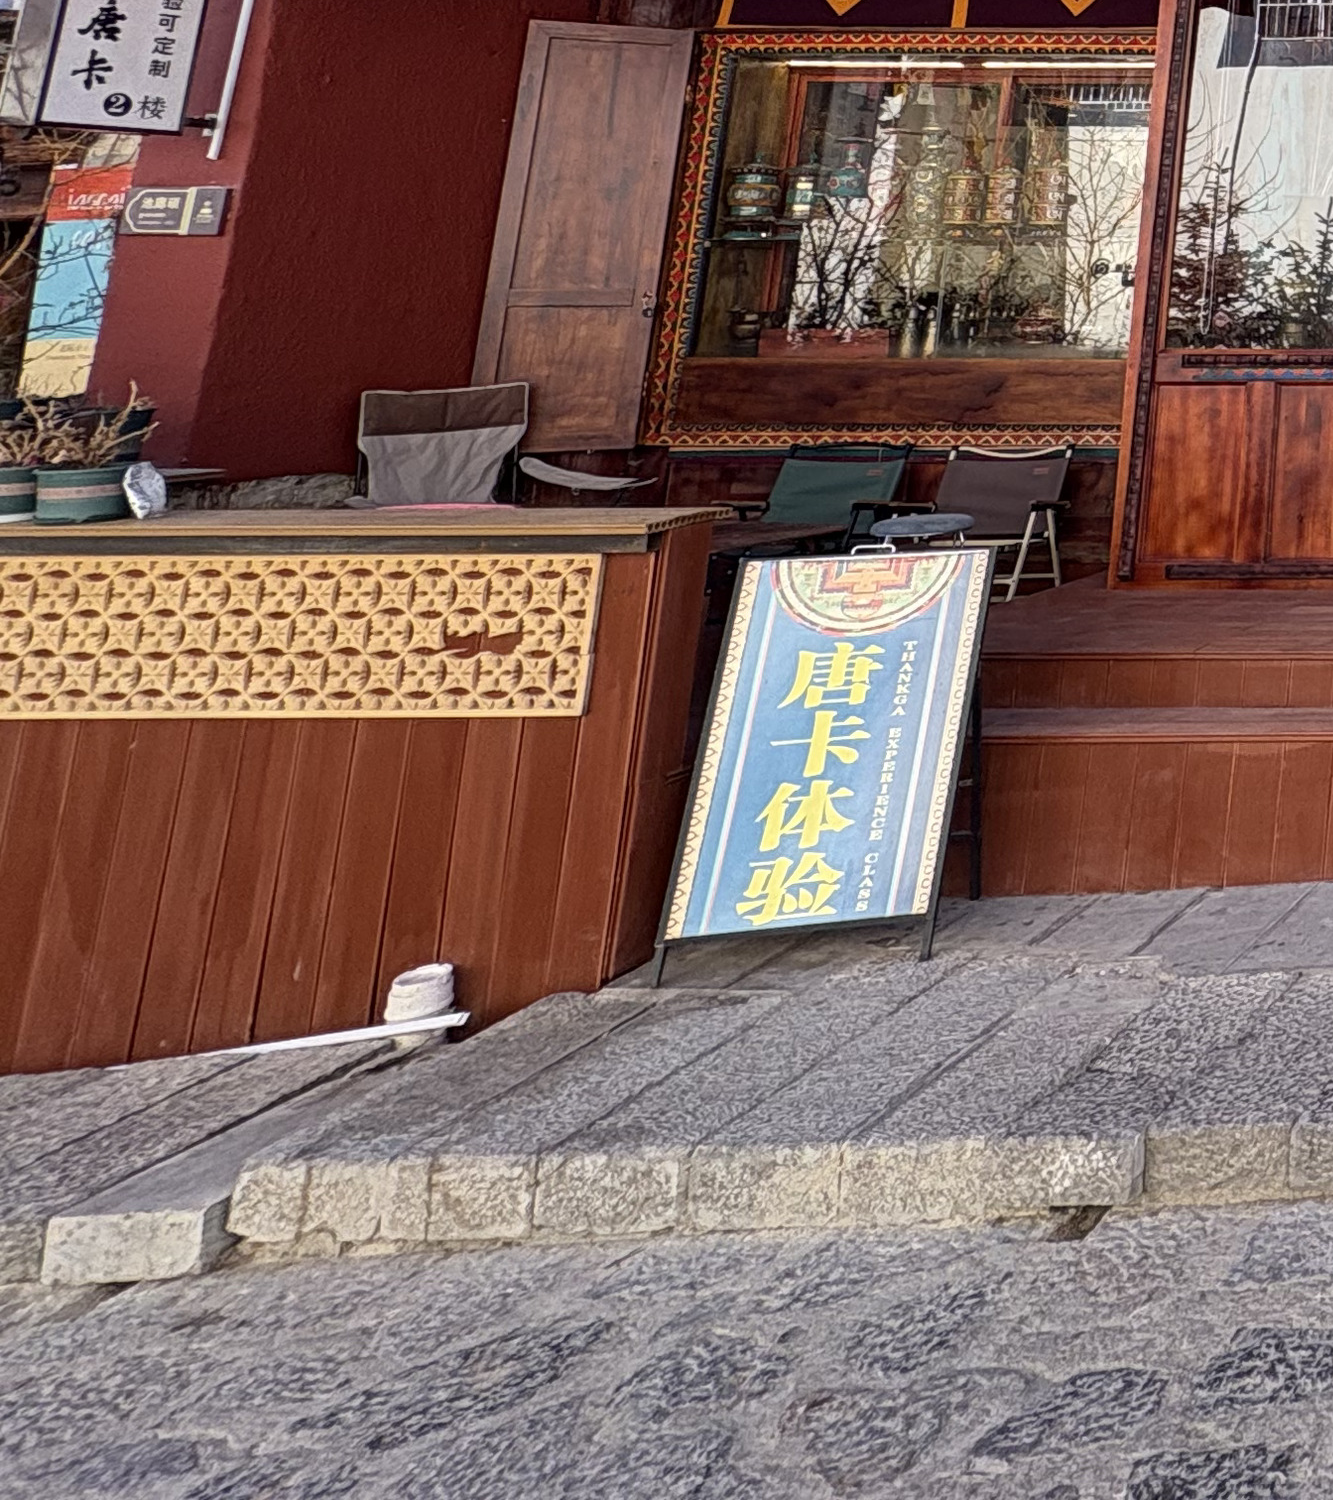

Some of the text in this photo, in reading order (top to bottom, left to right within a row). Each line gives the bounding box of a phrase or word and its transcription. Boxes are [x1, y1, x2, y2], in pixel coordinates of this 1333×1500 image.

[736, 641, 886, 928] 唐卡体验
[855, 640, 919, 912] THANKGA EXPERIENCE CLASS
